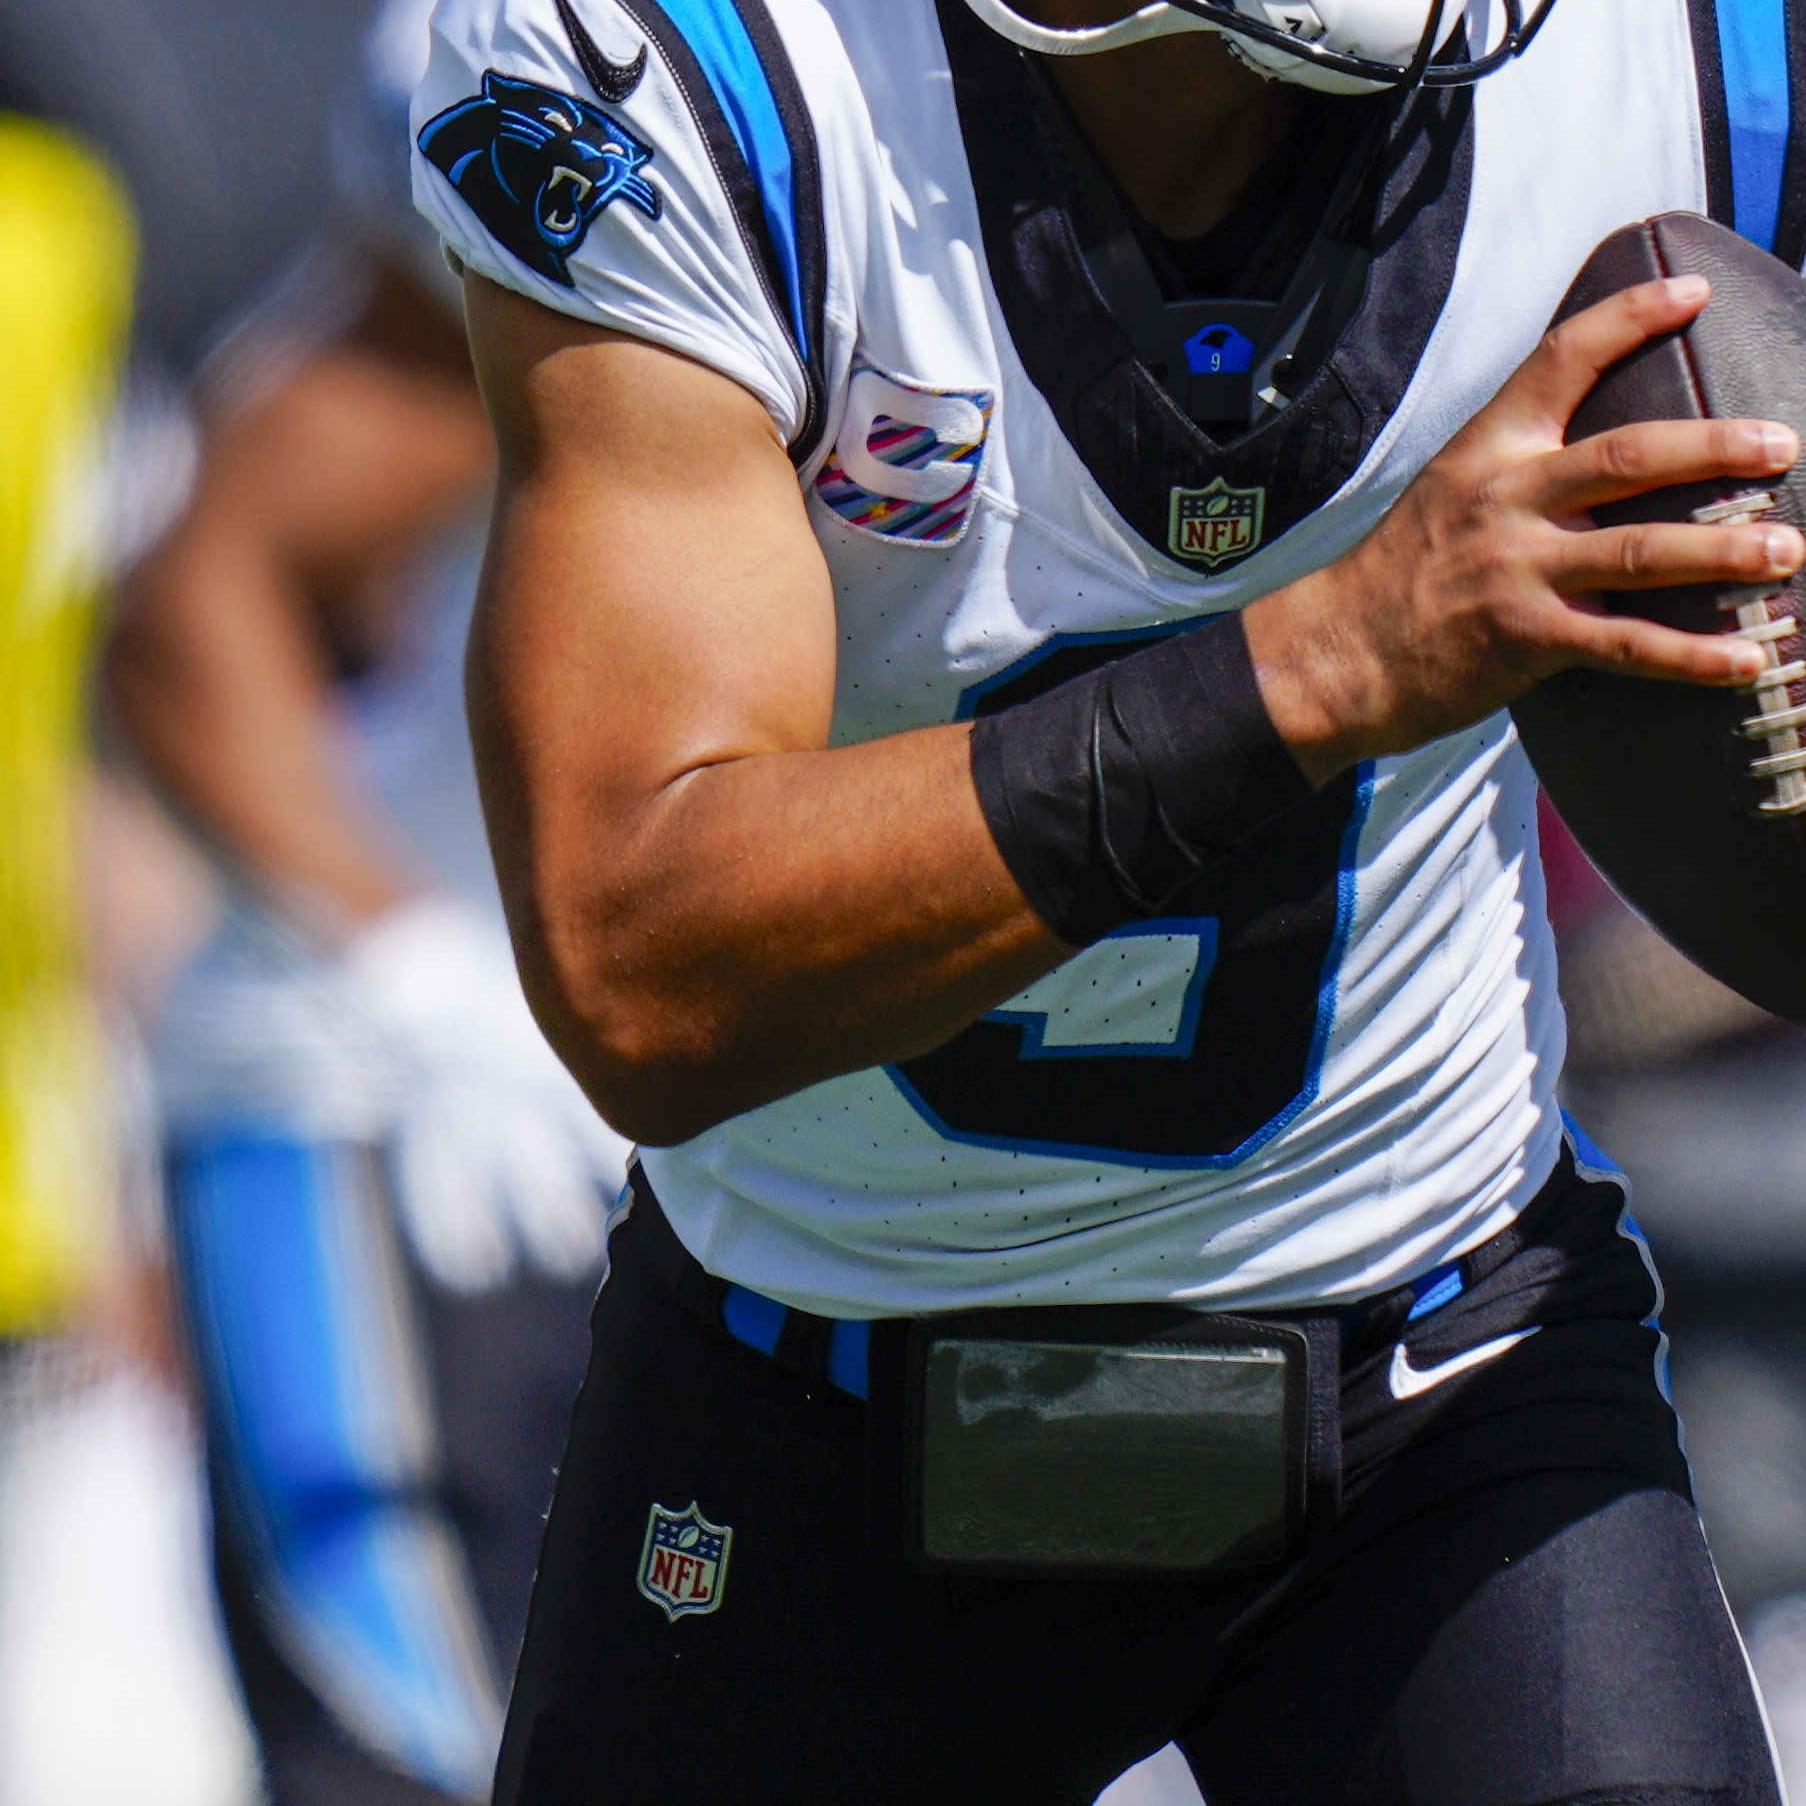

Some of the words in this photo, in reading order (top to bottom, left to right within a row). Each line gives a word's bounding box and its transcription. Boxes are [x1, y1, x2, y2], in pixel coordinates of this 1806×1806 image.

[1210, 352, 1222, 372] 9
[836, 370, 984, 505] C
[1185, 519, 1248, 552] NFL
[650, 1547, 709, 1599] NFL
